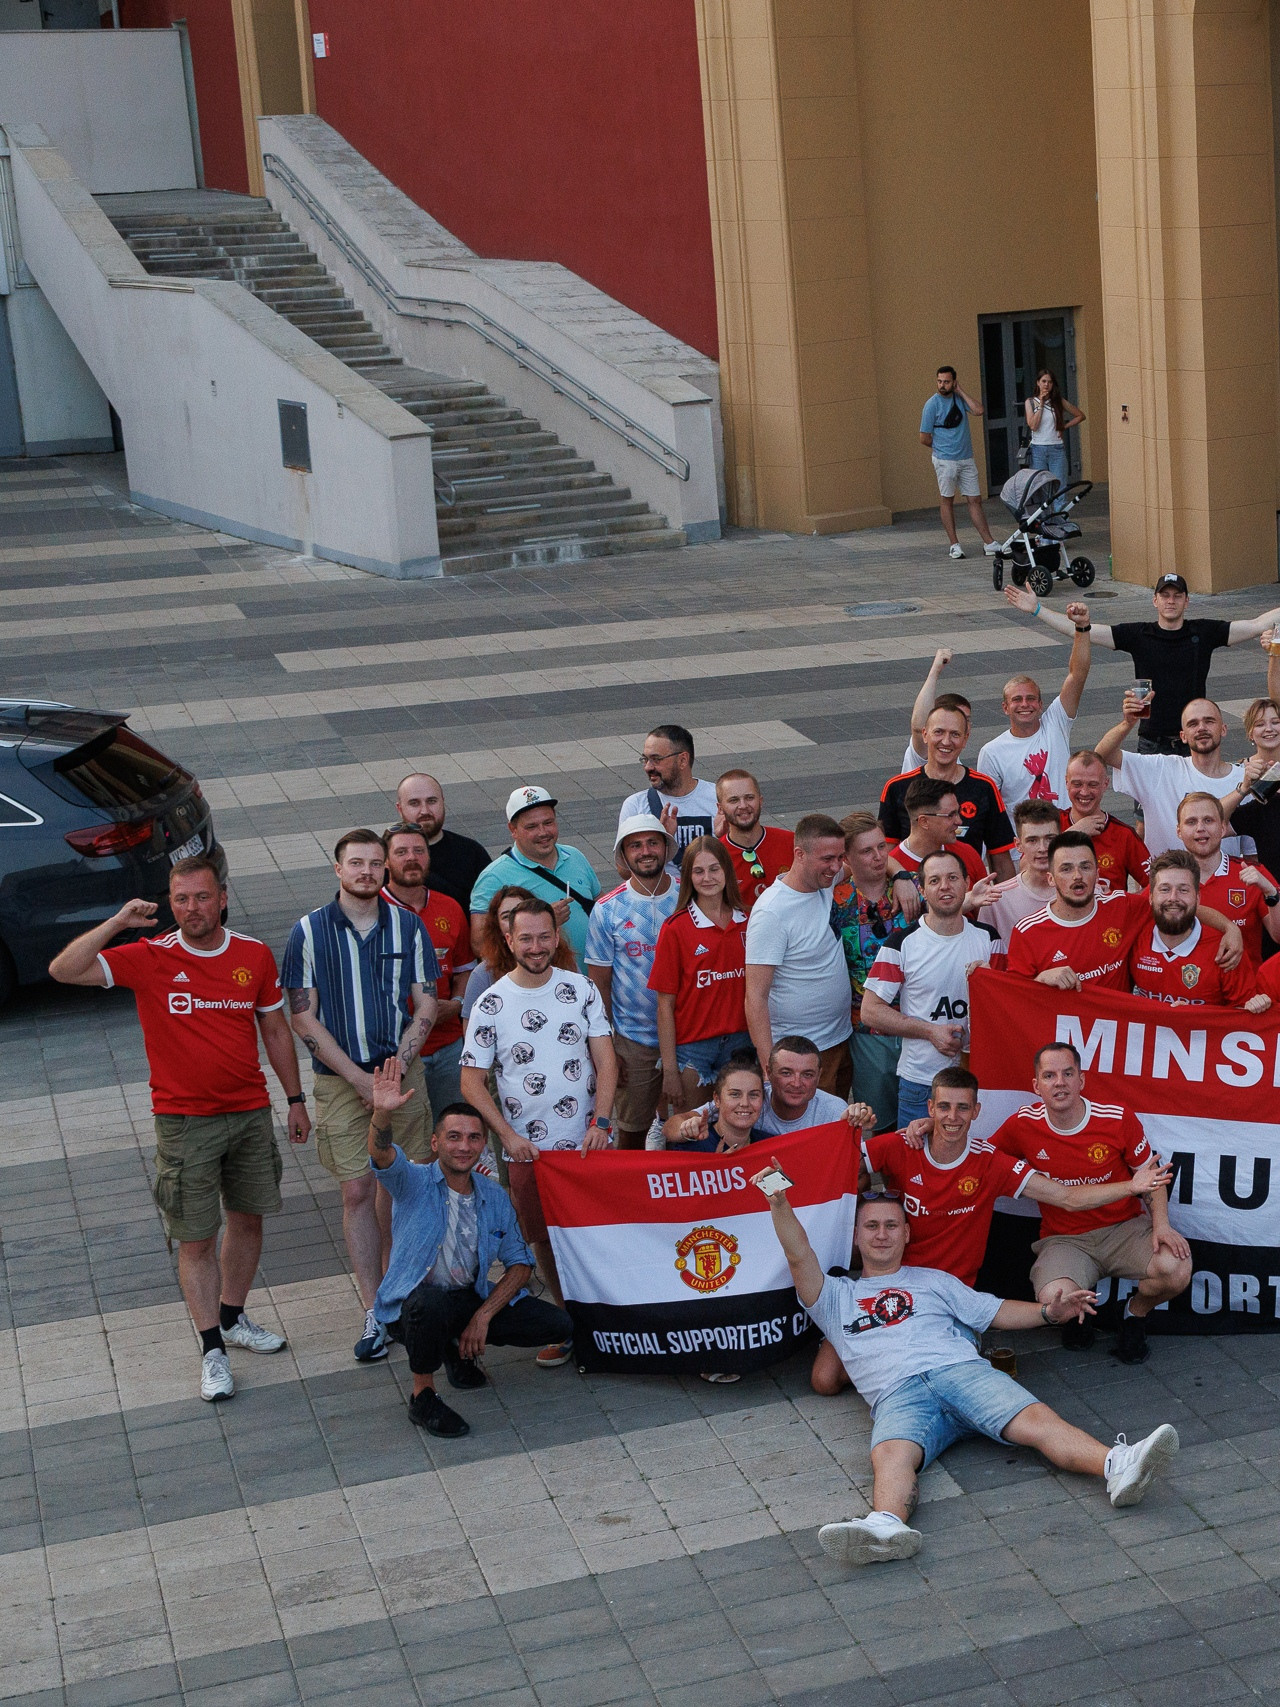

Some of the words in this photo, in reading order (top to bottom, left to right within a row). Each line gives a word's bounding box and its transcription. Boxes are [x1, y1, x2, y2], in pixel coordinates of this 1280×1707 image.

[710, 969, 745, 981] TeamVi
[1076, 960, 1123, 981] TeamView
[1137, 963, 1163, 973] UMBRO
[192, 998, 255, 1009] TeamViewer
[929, 996, 968, 1021] Ao
[646, 1166, 747, 1199] BELARUS
[681, 1230, 734, 1254] MANCHESTER
[691, 1275, 727, 1289] UNITED
[593, 1330, 667, 1356] OFFICIAL
[792, 1312, 811, 1337] CL
